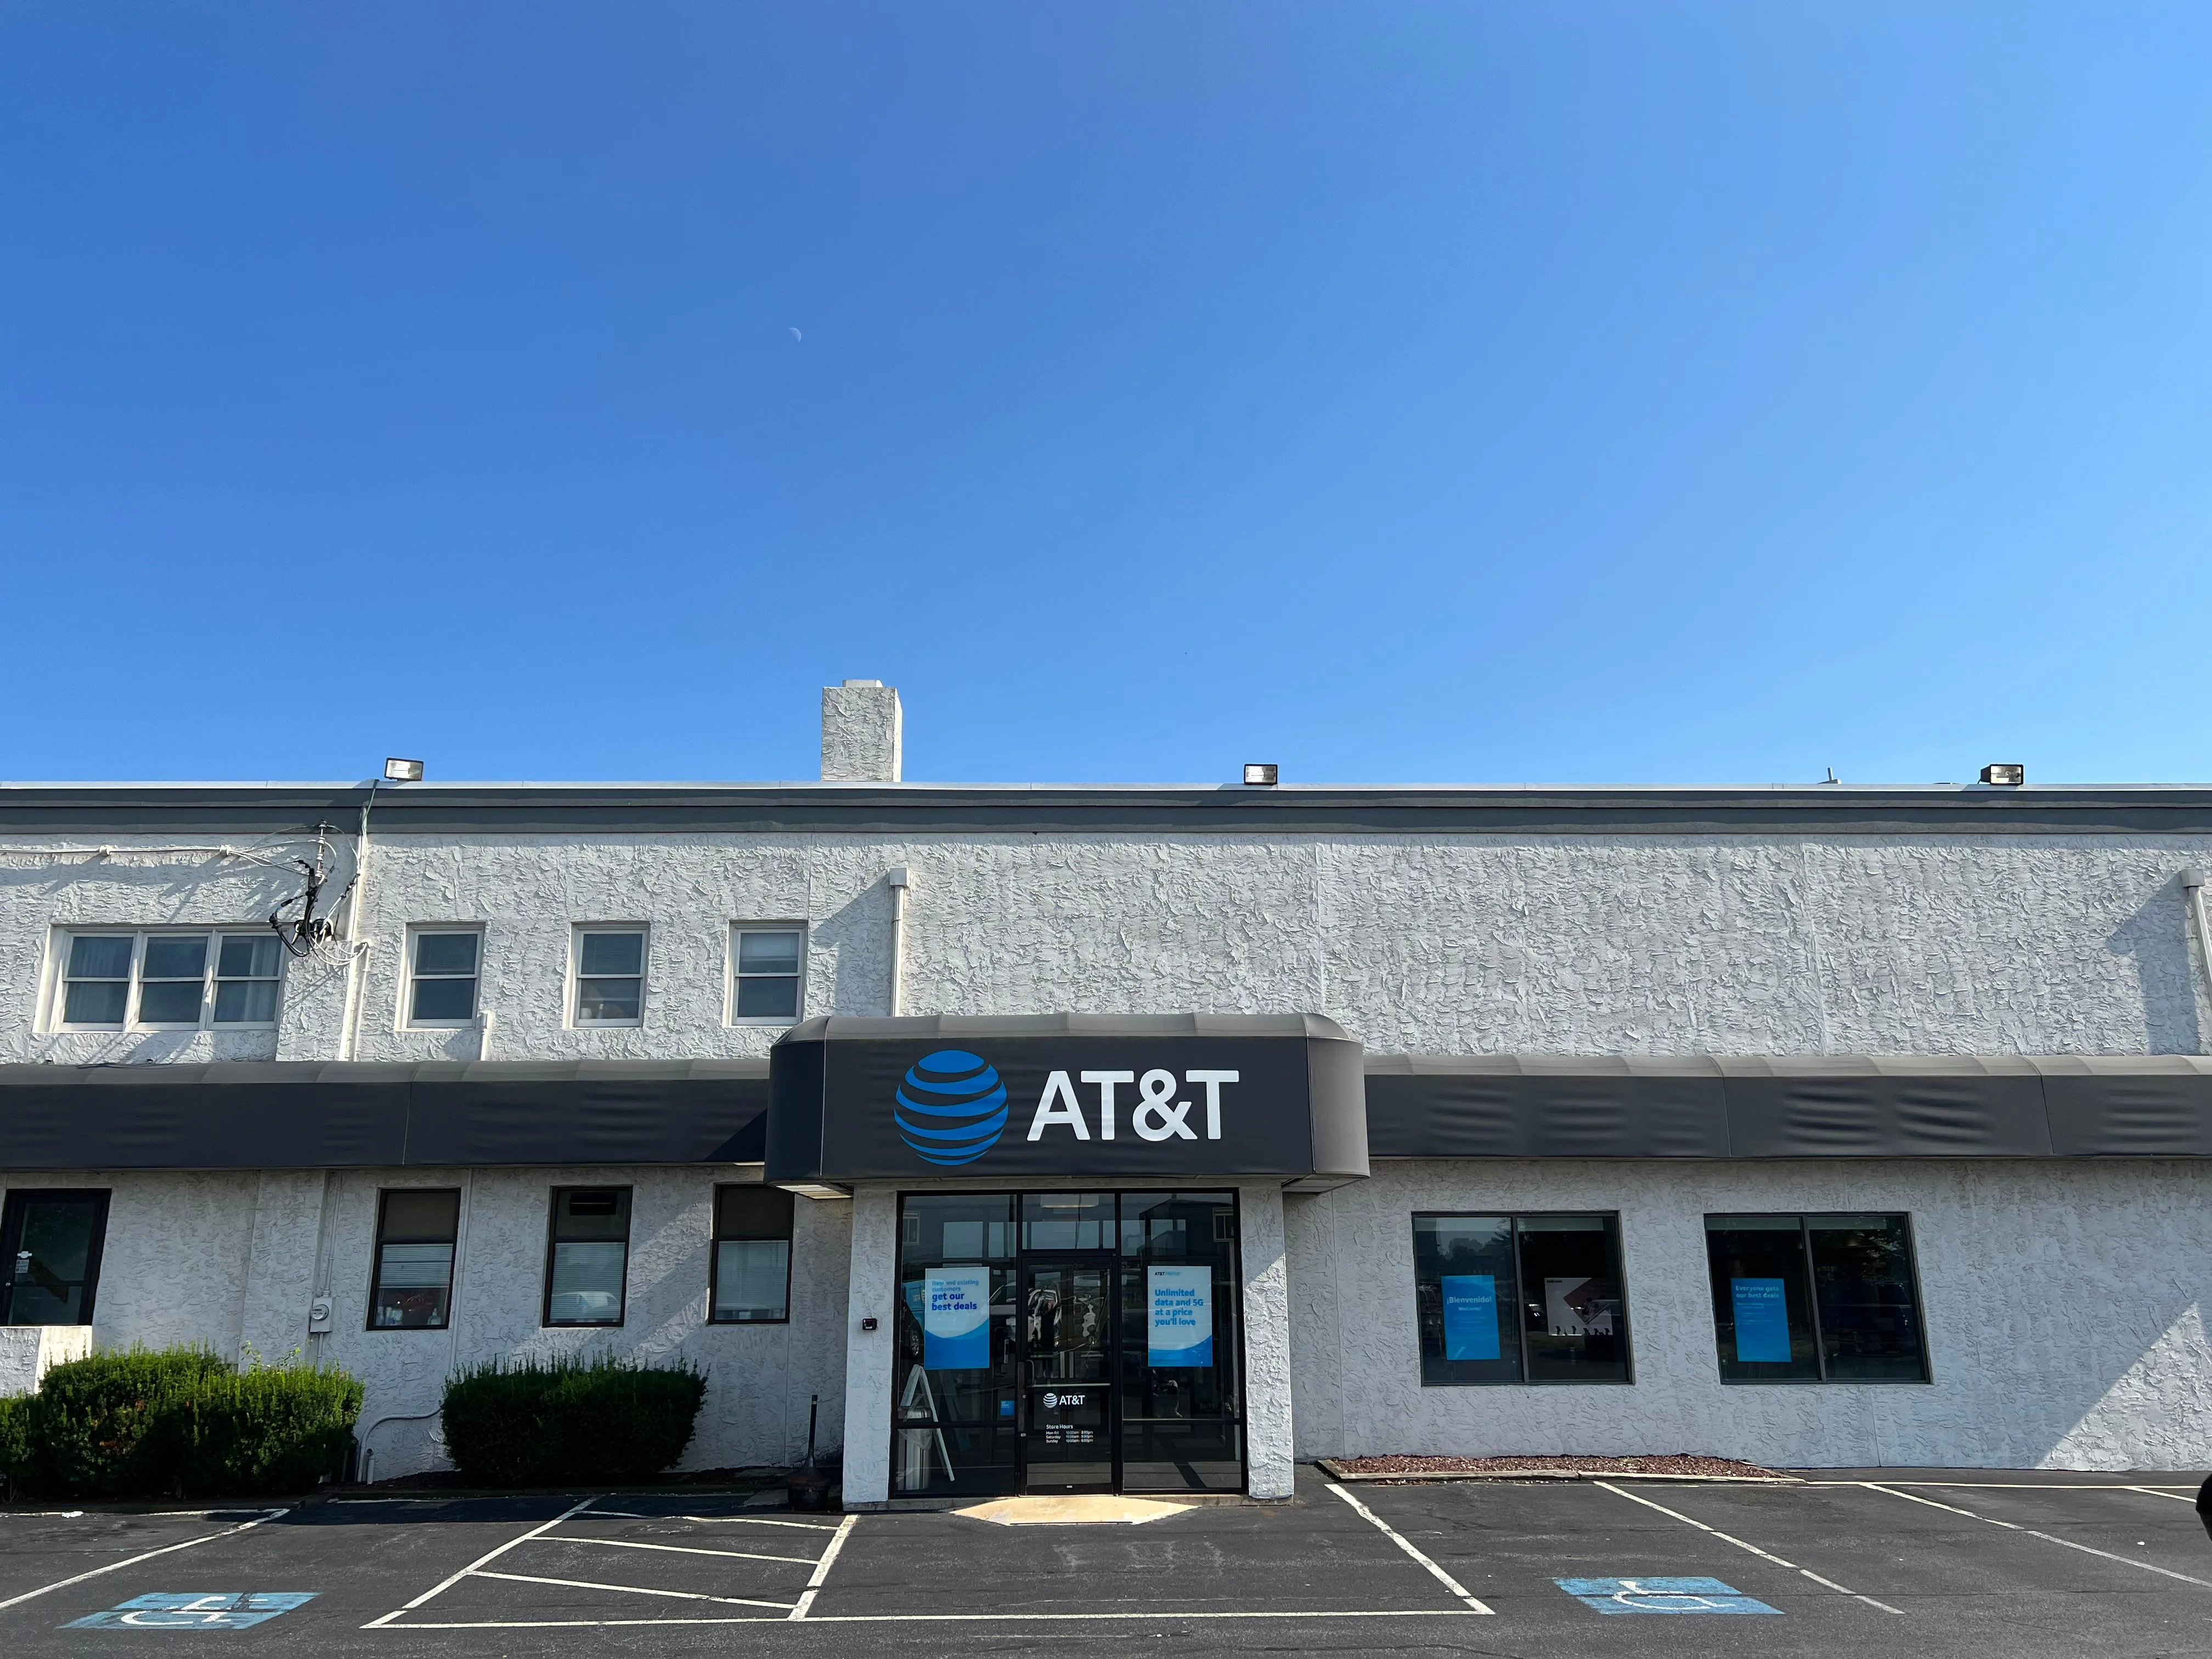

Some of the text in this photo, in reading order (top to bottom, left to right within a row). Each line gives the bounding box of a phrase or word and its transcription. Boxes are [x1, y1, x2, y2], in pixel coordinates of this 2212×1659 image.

[1026, 1068, 1239, 1142] AT&T
[932, 1293, 947, 1302] get
[1447, 1295, 1492, 1305] ¡Bienvenido!
[932, 1302, 977, 1311] best deals
[1172, 1308, 1193, 1317] price
[1155, 1318, 1177, 1327] you'll
[1059, 1395, 1085, 1405] AT&T
